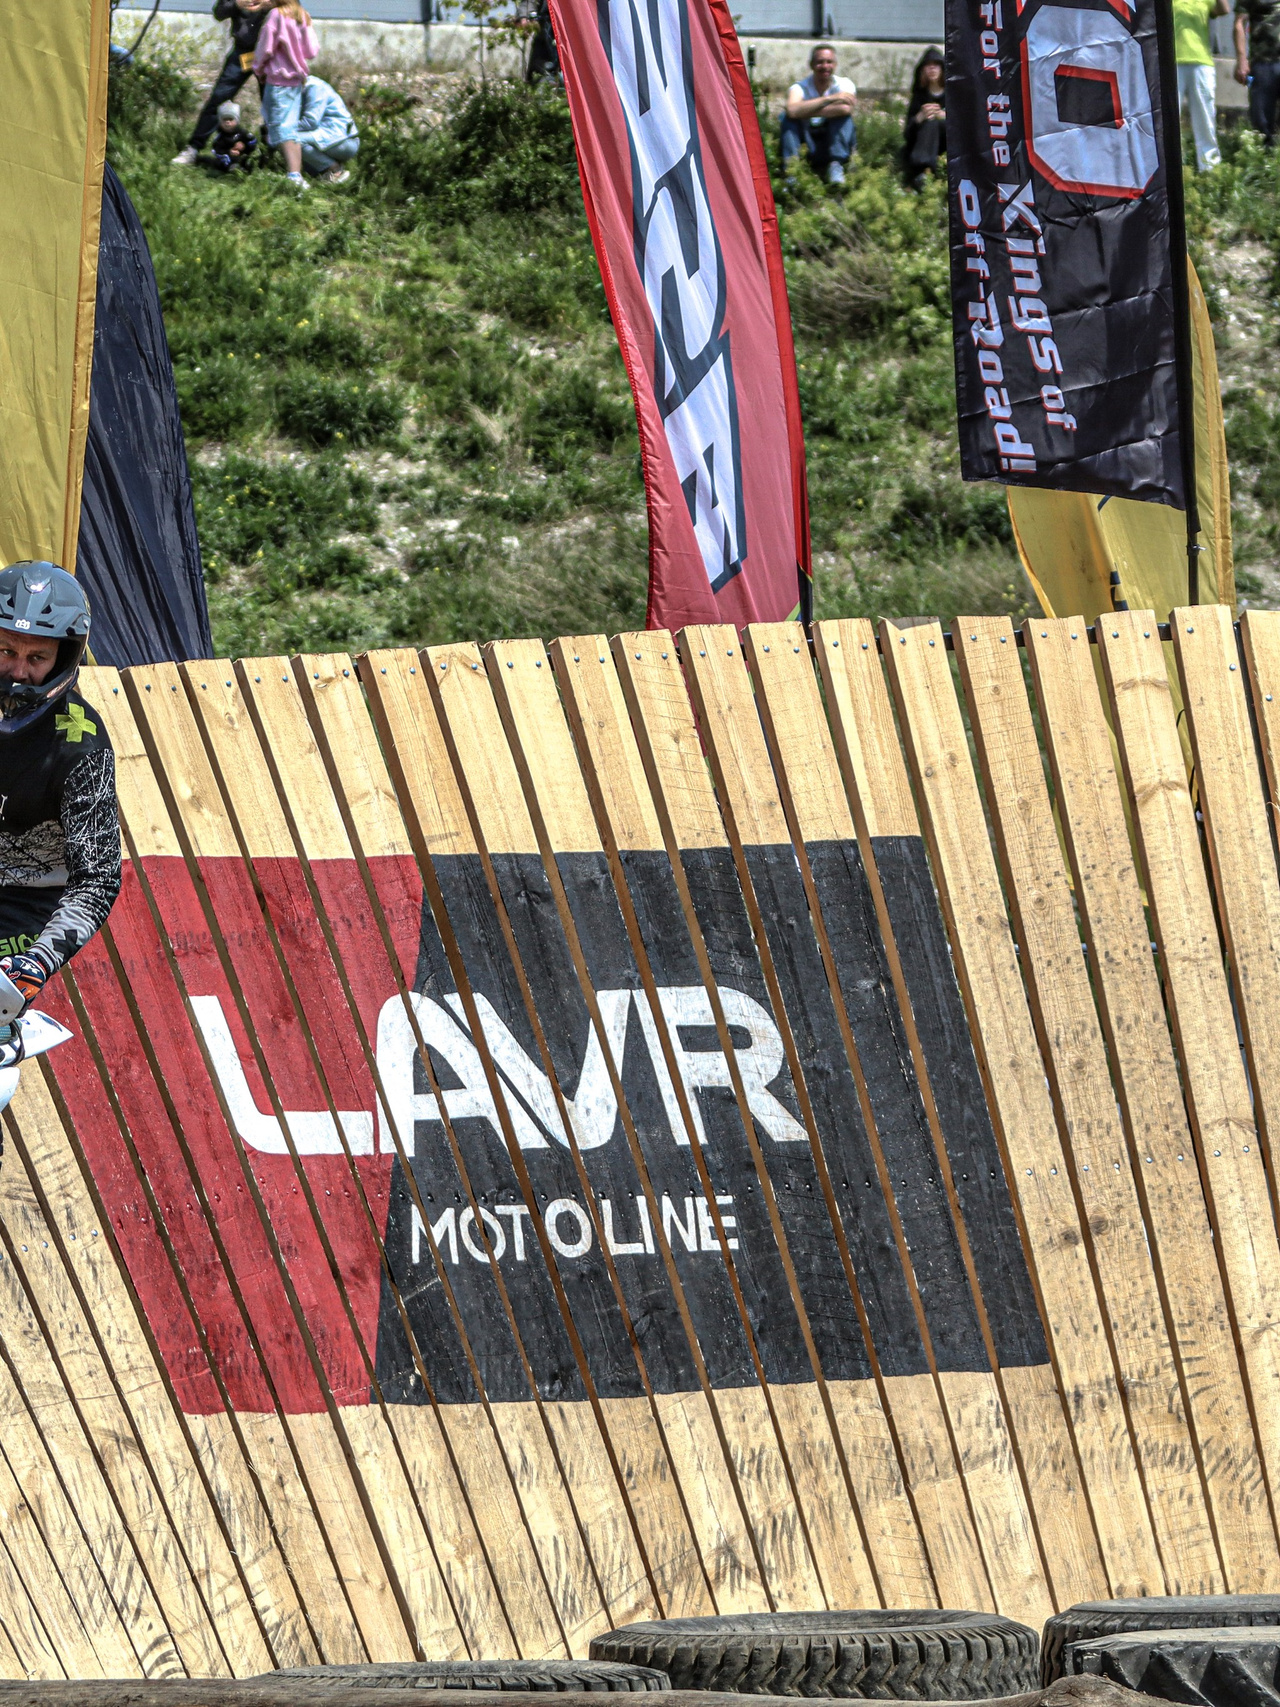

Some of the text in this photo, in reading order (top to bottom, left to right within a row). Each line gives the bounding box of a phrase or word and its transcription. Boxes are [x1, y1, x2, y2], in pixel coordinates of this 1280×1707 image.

[979, 0, 1078, 432] For the Kings of
[186, 985, 810, 1157] LAVR
